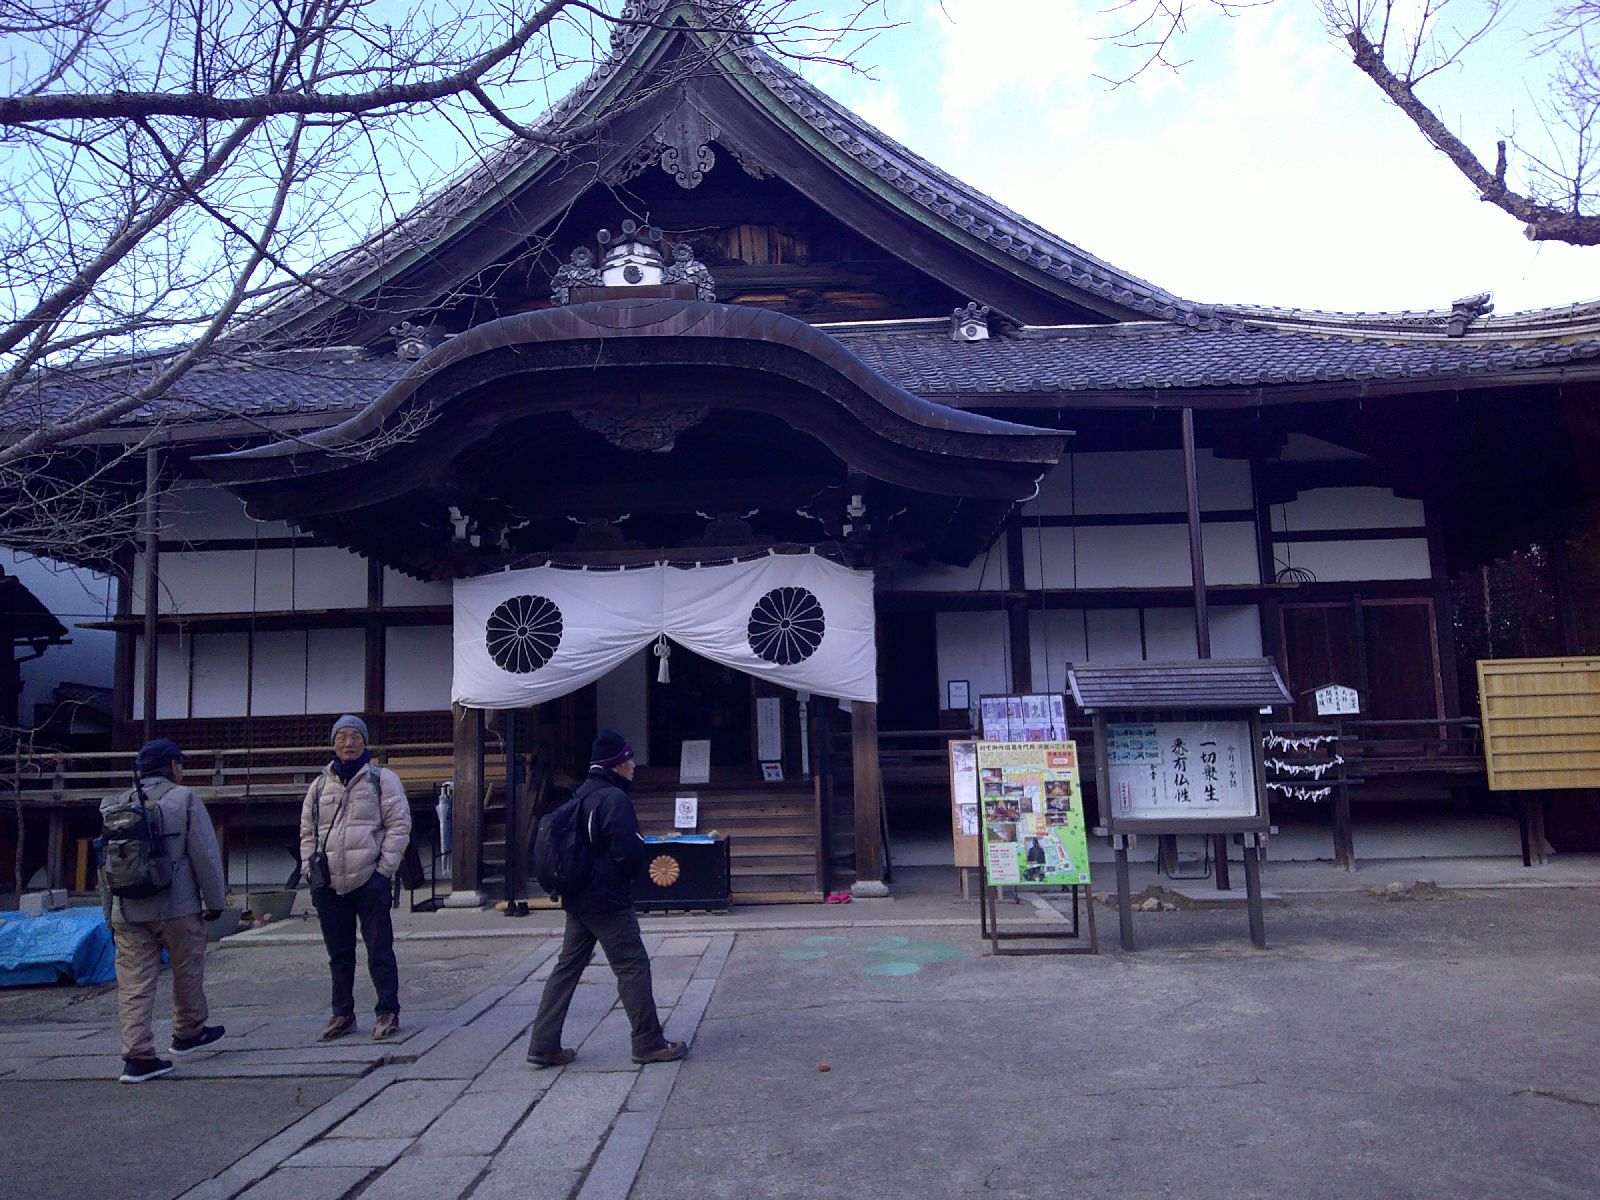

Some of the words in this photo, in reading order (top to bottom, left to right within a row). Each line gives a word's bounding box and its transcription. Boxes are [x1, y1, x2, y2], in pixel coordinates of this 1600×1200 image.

[1172, 738, 1191, 803] 悉有仏性
[1199, 740, 1219, 802] 一切衆生
